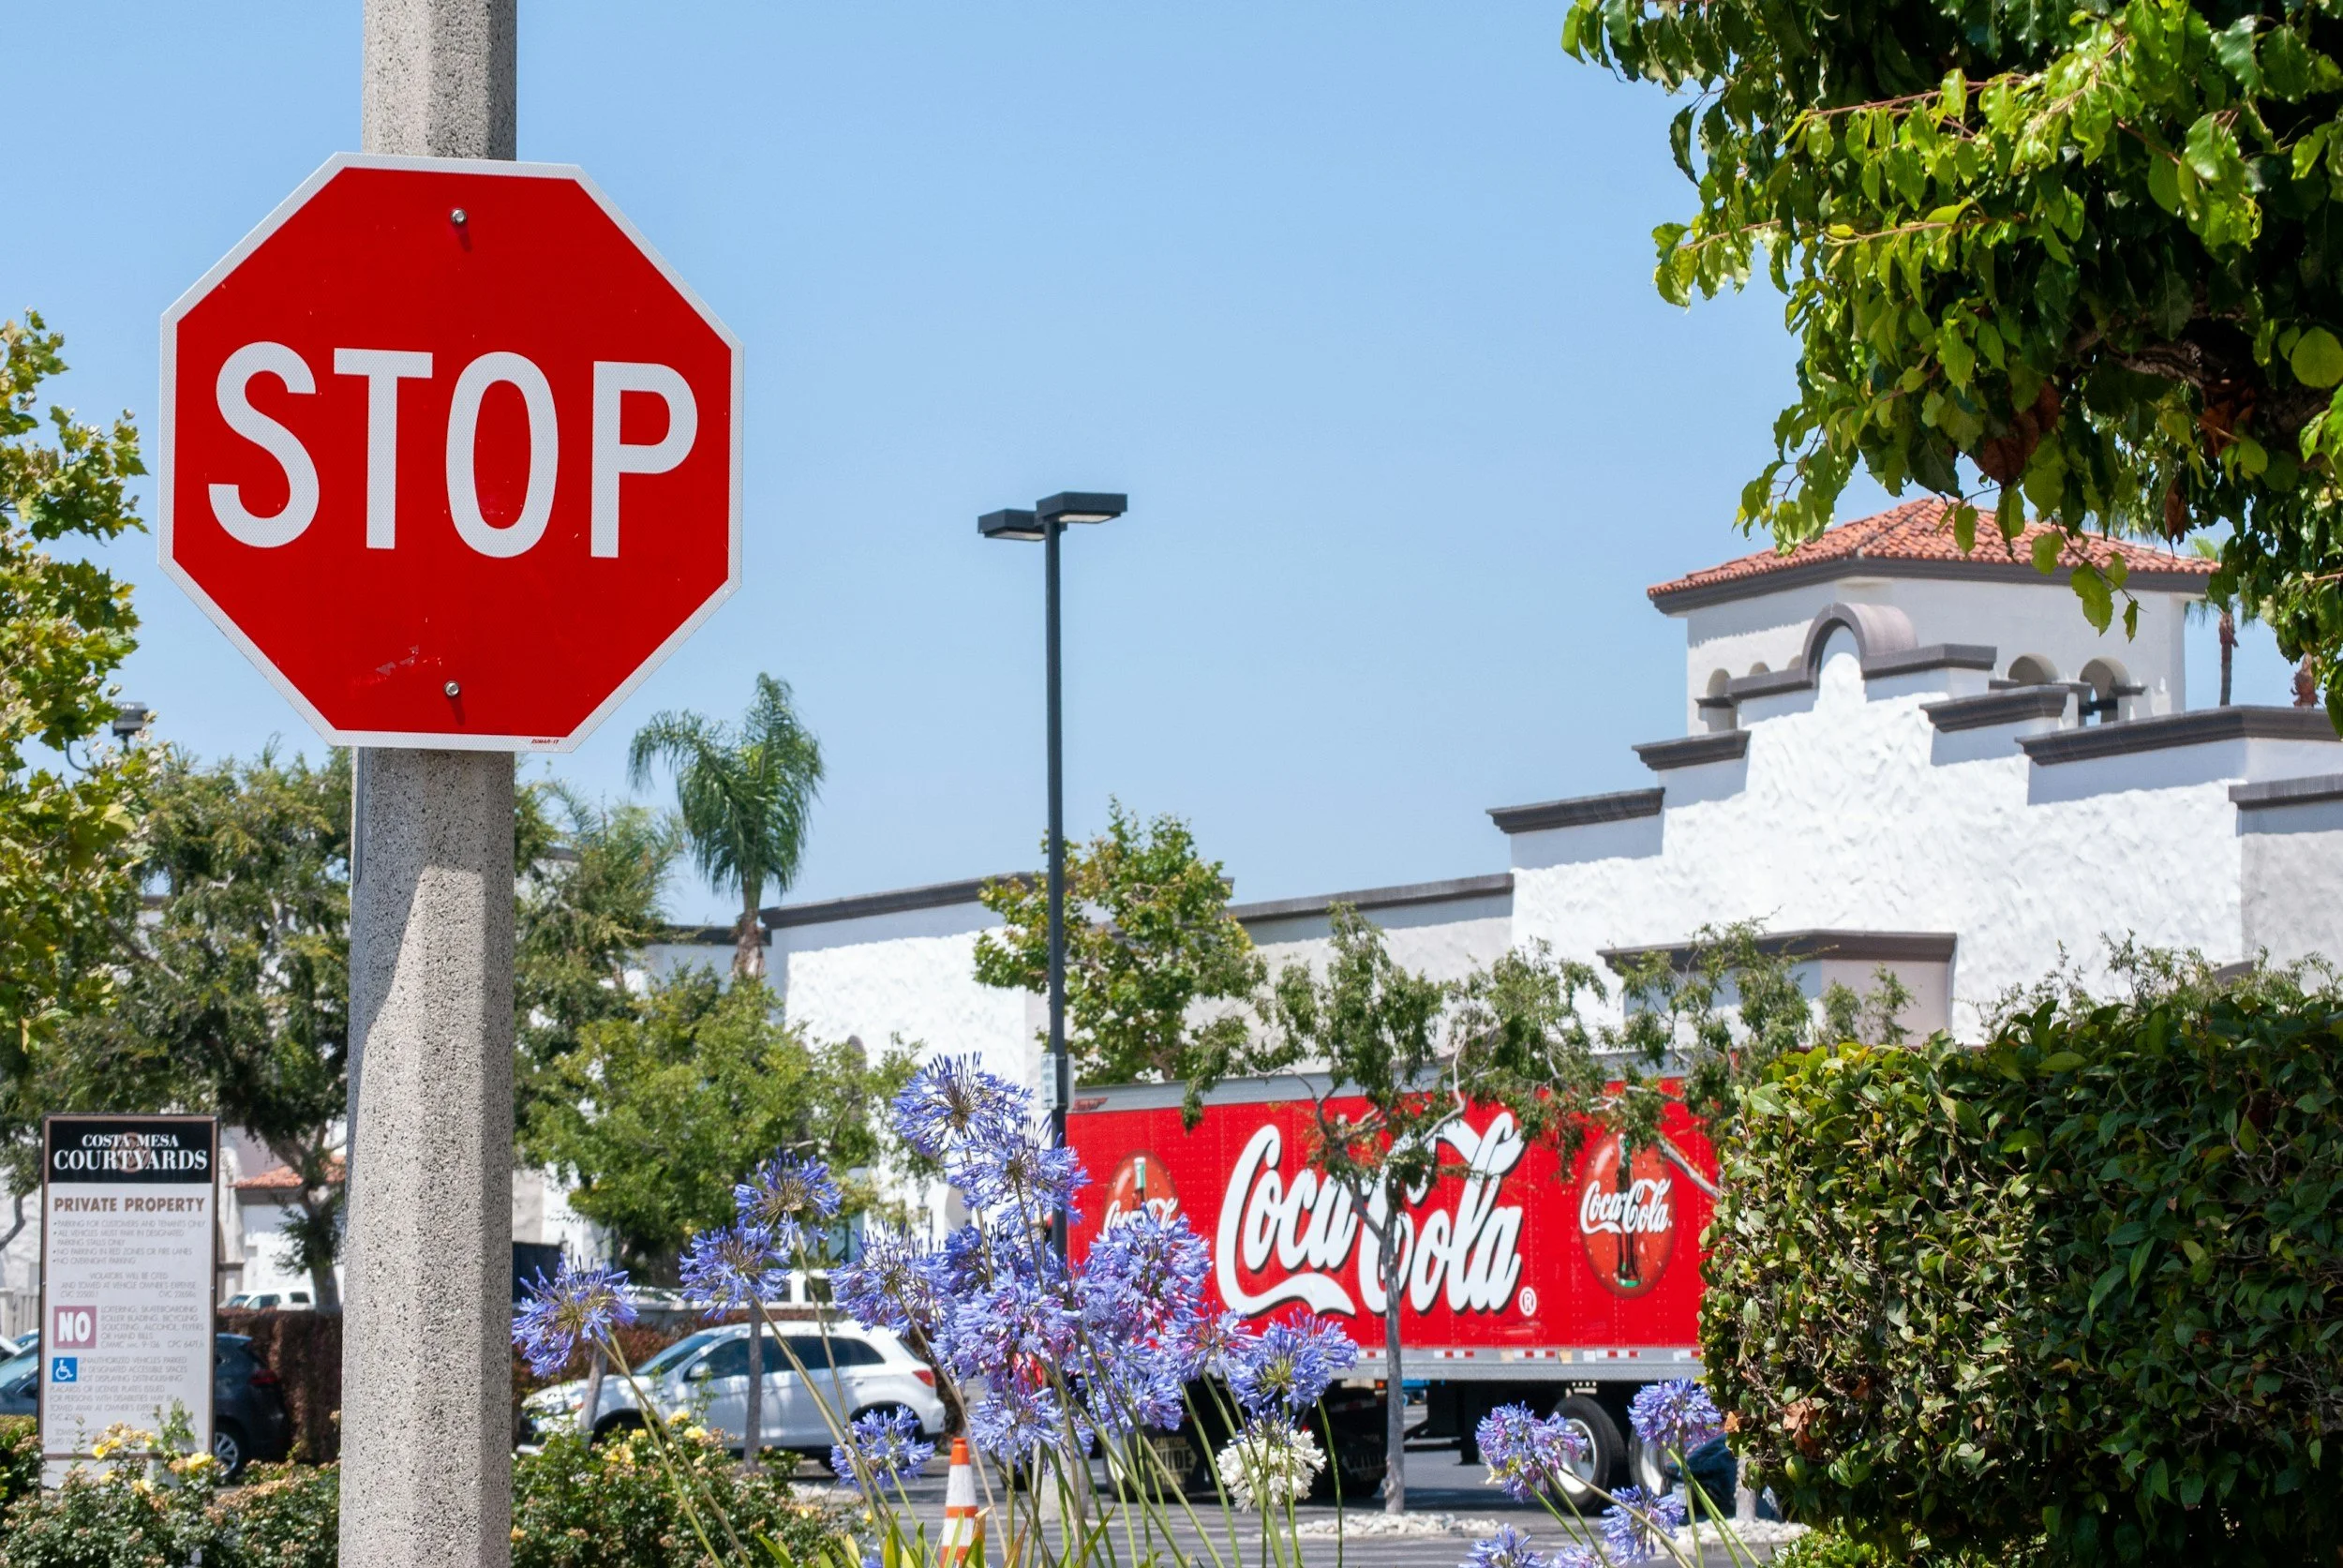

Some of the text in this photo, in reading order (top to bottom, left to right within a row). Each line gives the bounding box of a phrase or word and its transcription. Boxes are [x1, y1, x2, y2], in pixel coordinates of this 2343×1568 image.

[208, 340, 698, 559] STOP
[82, 1134, 179, 1148] COSTA MESA
[53, 1150, 208, 1170] COURTYARDS
[53, 1197, 205, 1212] PRIVATE PROPERTY
[1580, 1178, 1672, 1235] Coca-Cola
[58, 1312, 91, 1343] NO
